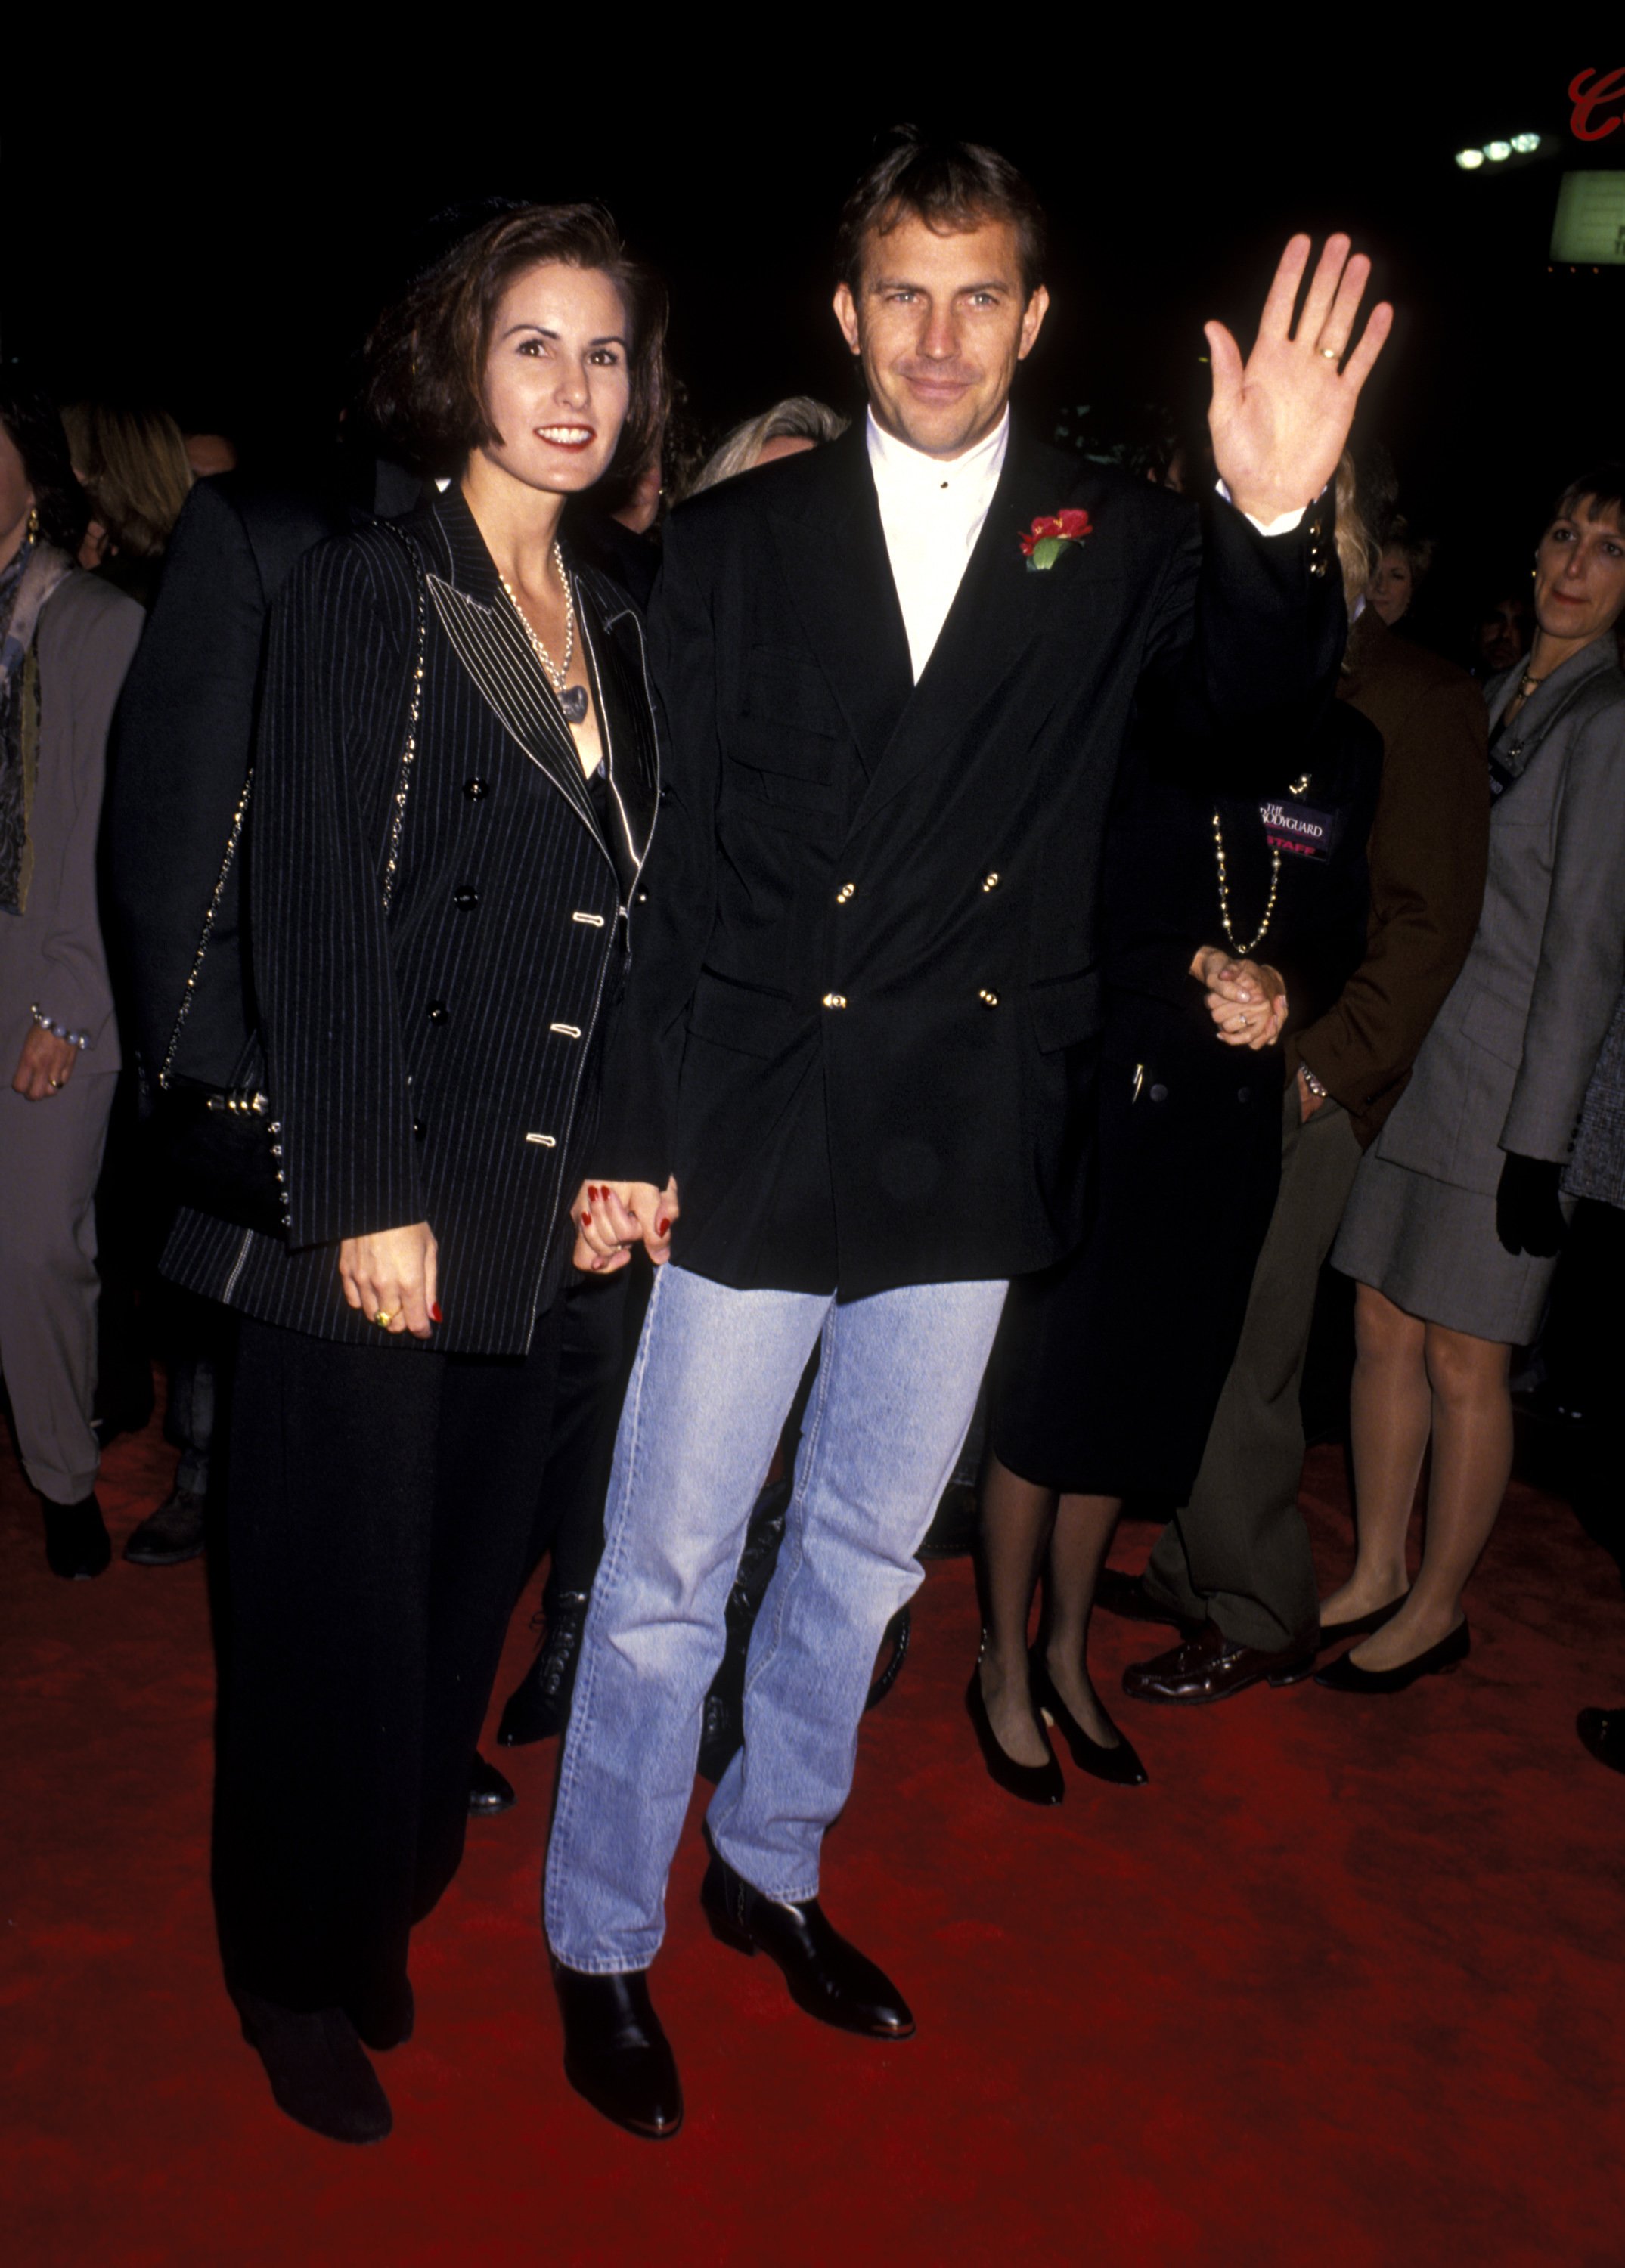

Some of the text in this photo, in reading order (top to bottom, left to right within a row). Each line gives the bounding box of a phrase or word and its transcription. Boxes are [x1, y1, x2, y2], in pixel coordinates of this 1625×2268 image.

[1568, 67, 1625, 141] C
[1267, 803, 1283, 816] THE
[1266, 835, 1316, 855] STAFF
